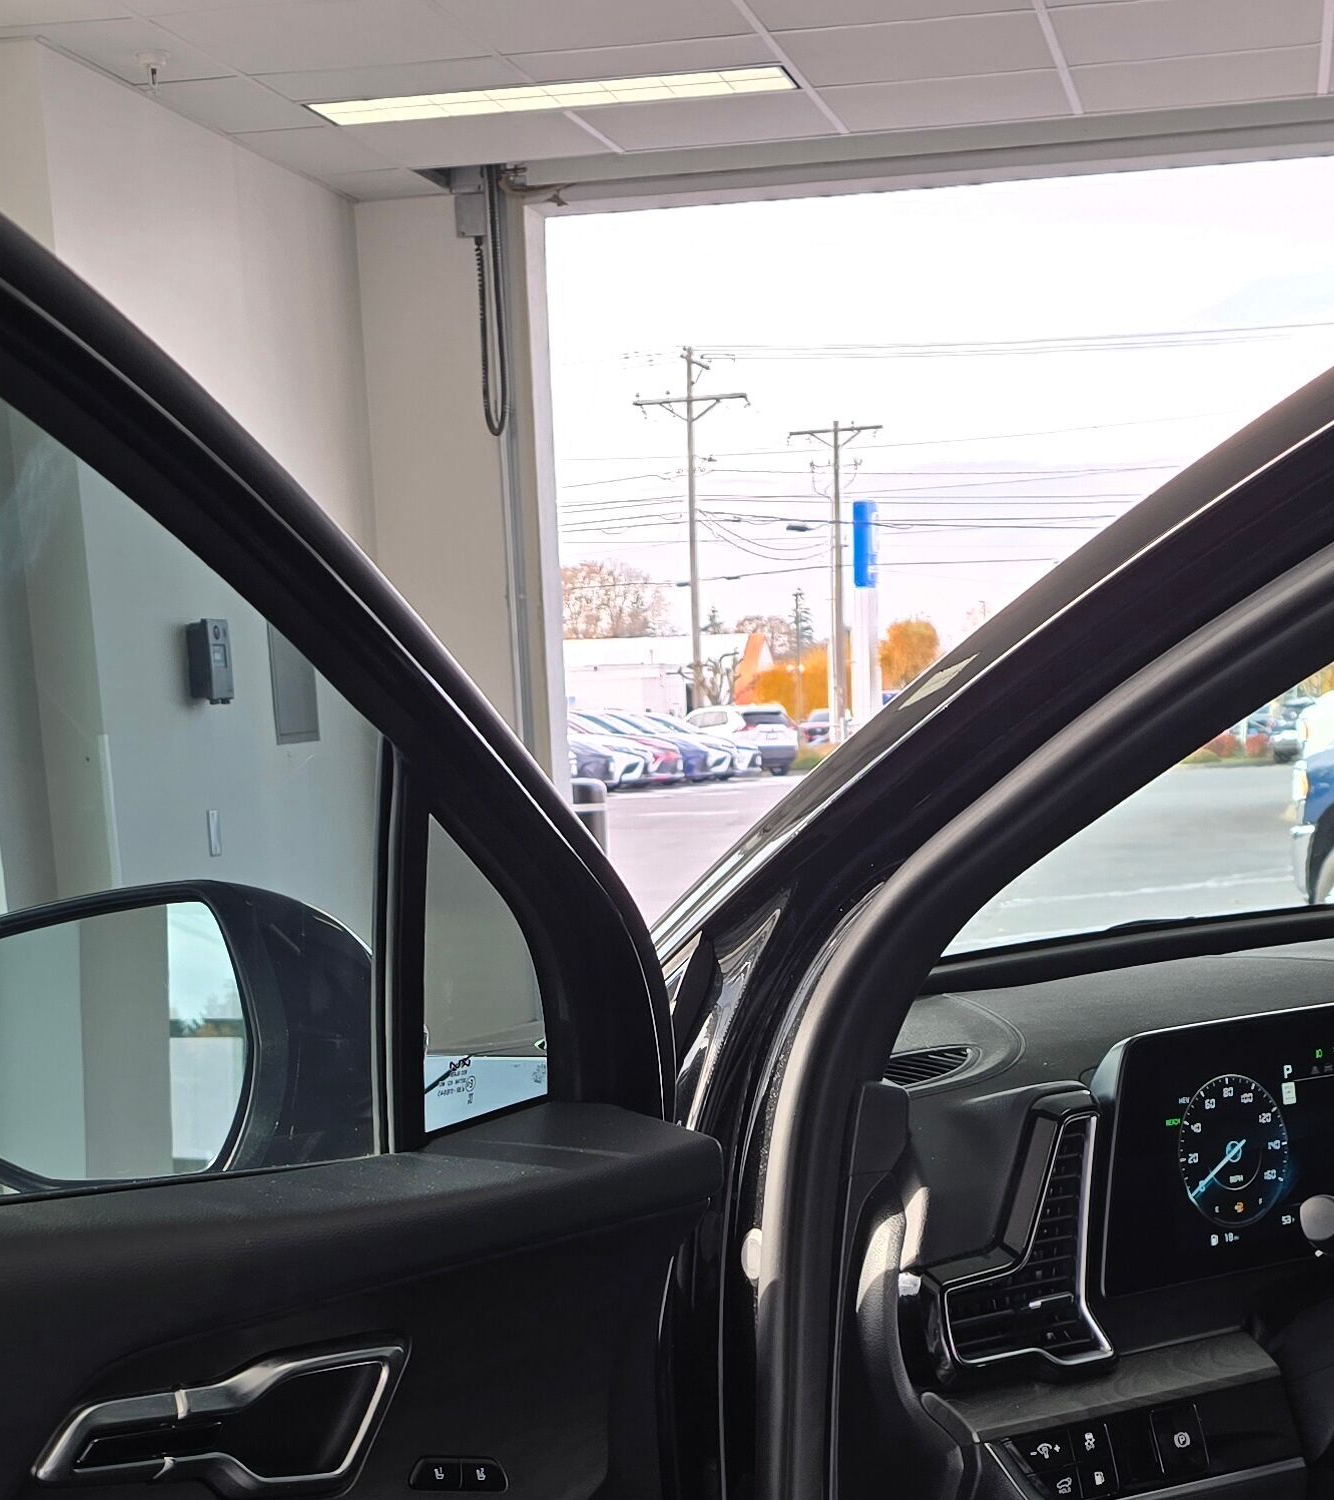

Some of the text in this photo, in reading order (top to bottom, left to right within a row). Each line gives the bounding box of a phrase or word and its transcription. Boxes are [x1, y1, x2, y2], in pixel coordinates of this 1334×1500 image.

[1283, 1064, 1293, 1079] P
[1222, 1086, 1234, 1098] 80
[1240, 1092, 1254, 1104] 100
[1204, 1098, 1216, 1110] 60
[1258, 1112, 1272, 1124] 120
[1191, 1122, 1202, 1133] 40
[1267, 1139, 1281, 1150] 140
[1189, 1153, 1199, 1164] 20
[1263, 1168, 1277, 1180] 160
